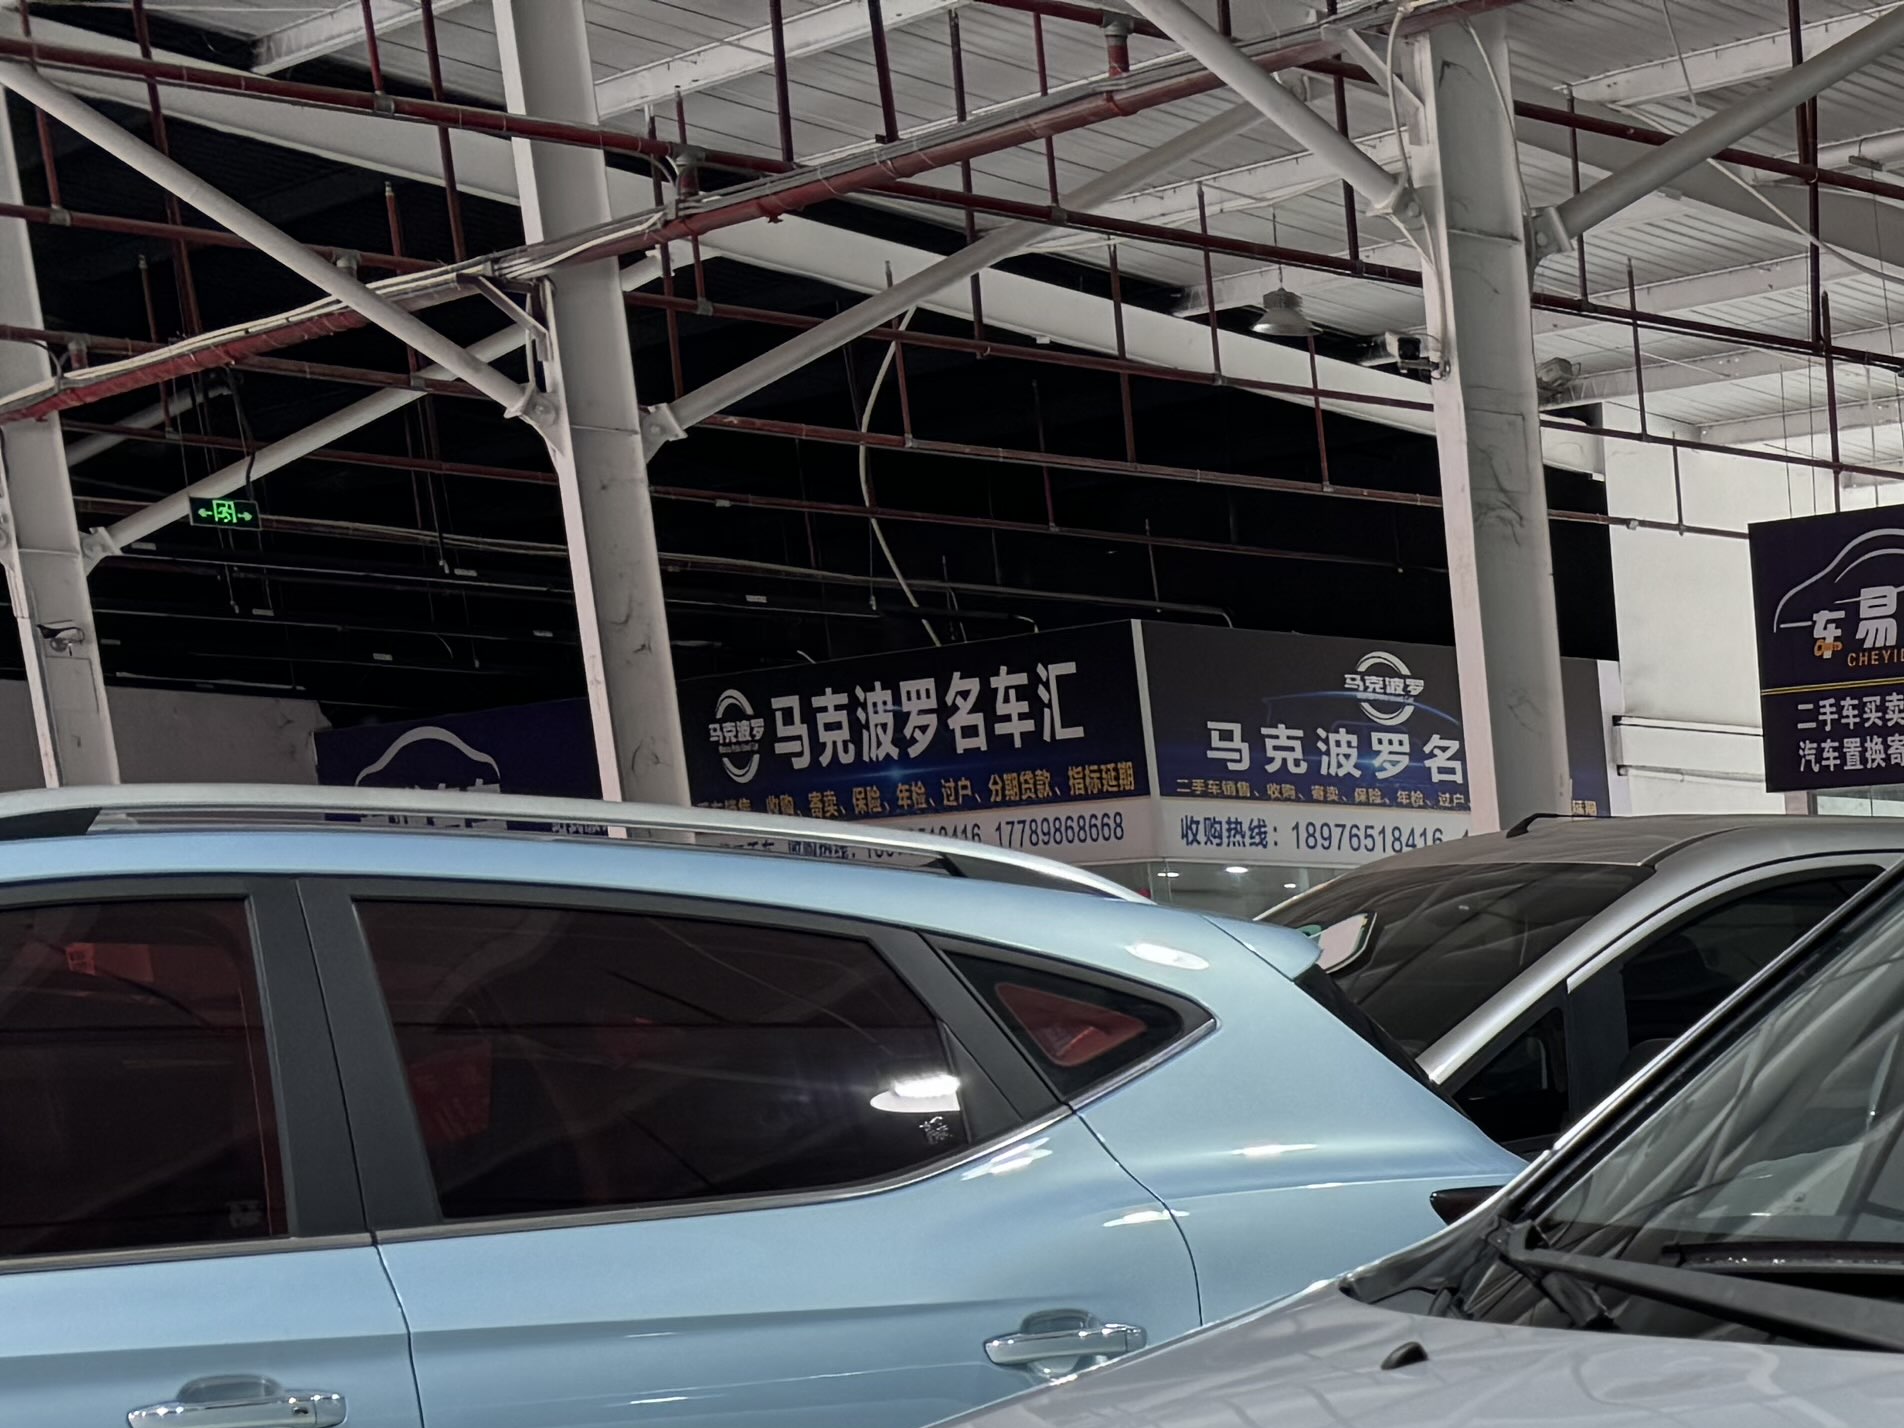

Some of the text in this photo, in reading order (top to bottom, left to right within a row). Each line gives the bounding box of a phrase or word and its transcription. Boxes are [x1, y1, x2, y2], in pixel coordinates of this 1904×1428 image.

[1344, 673, 1425, 696] 马克波罗
[771, 661, 1085, 770] 马克波罗名车汇
[1205, 720, 1465, 785] 马克波罗名
[994, 811, 1126, 849] 17789868668
